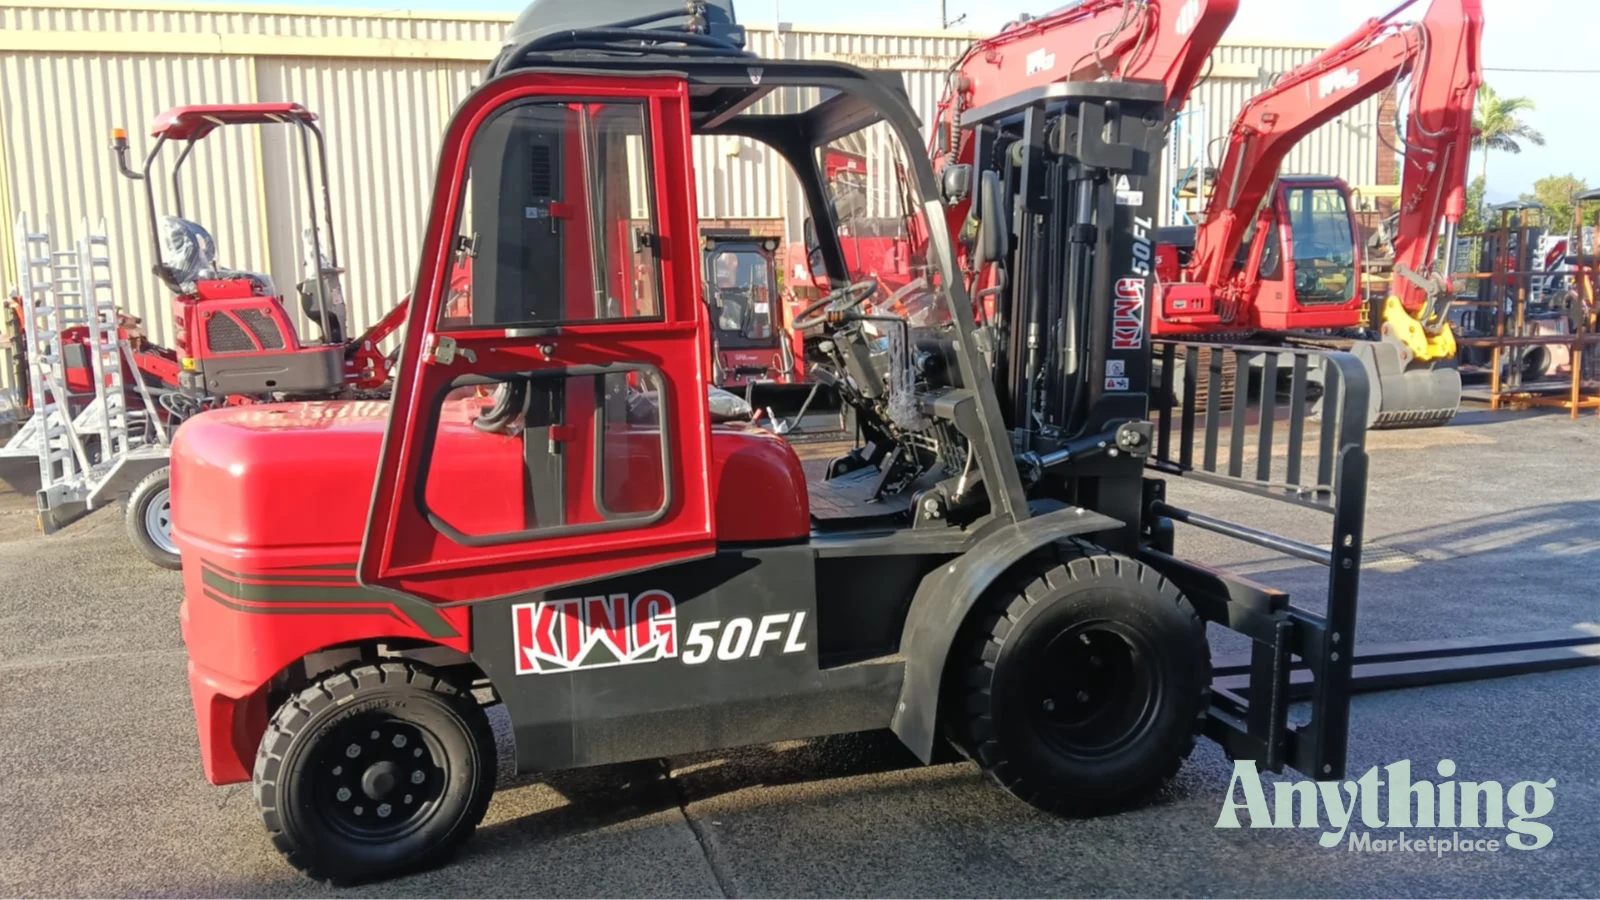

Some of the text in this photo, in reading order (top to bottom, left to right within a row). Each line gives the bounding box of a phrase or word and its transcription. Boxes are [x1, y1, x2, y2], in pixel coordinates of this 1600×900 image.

[1112, 216, 1152, 349] KING 50FL
[512, 589, 808, 675] KING 50FL
